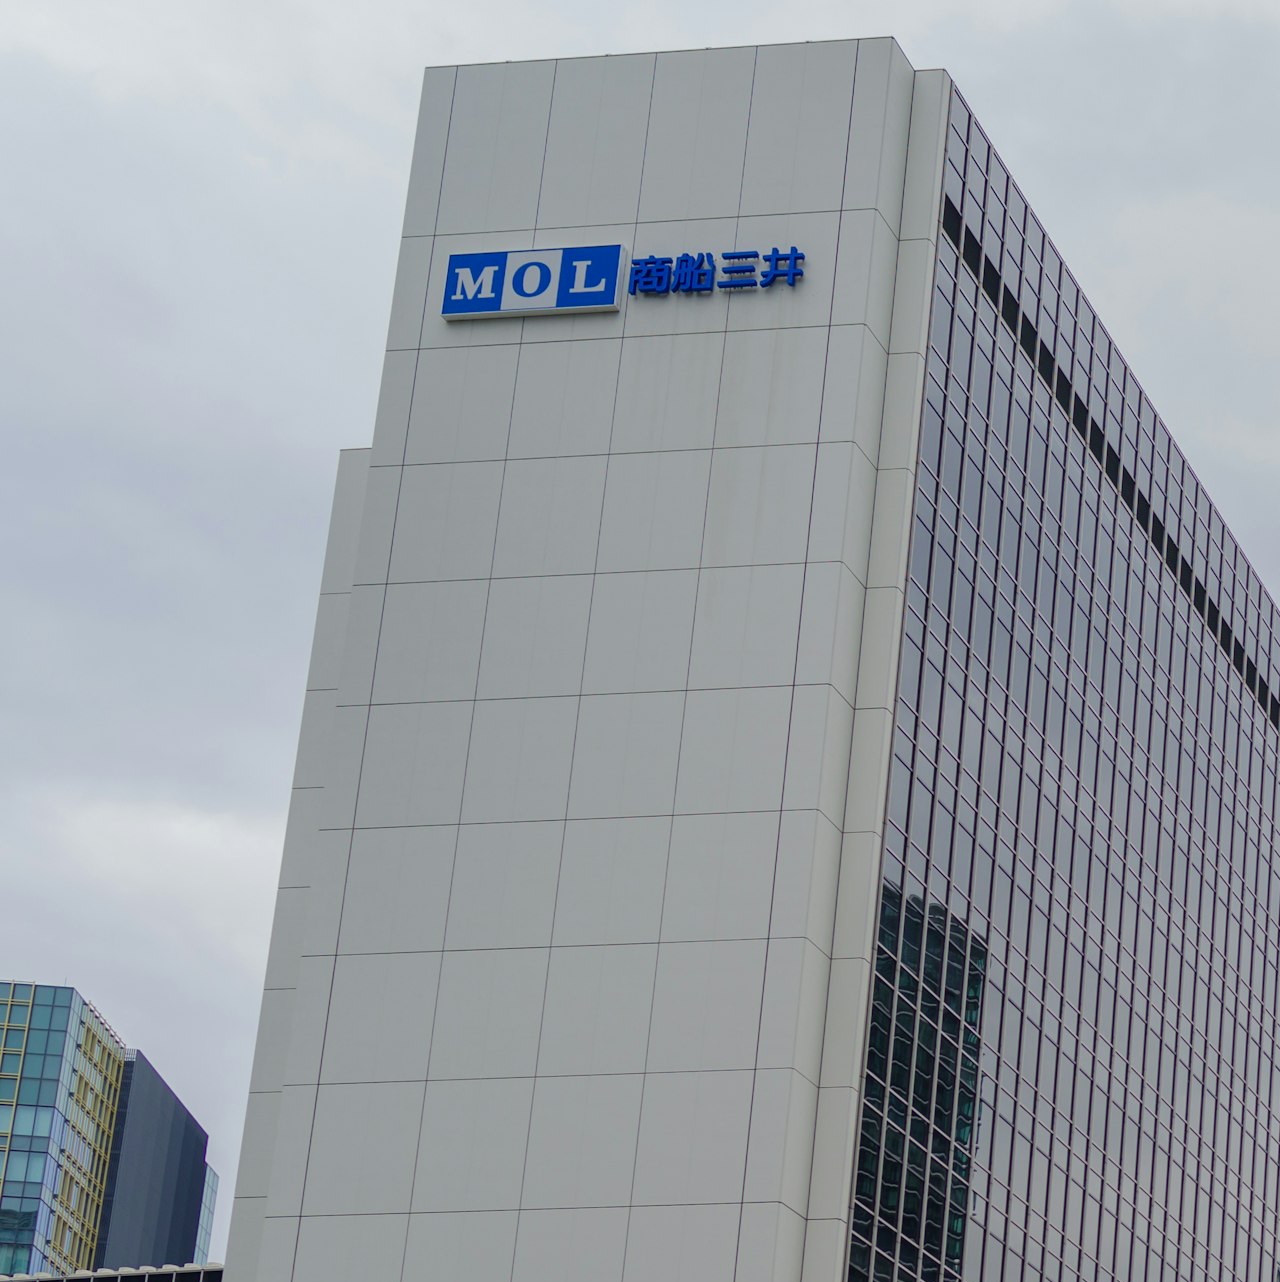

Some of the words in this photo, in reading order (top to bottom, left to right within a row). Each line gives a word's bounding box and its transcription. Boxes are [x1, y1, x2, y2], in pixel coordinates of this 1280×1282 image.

[451, 259, 606, 301] MOL
[628, 246, 805, 297] 商船三井
